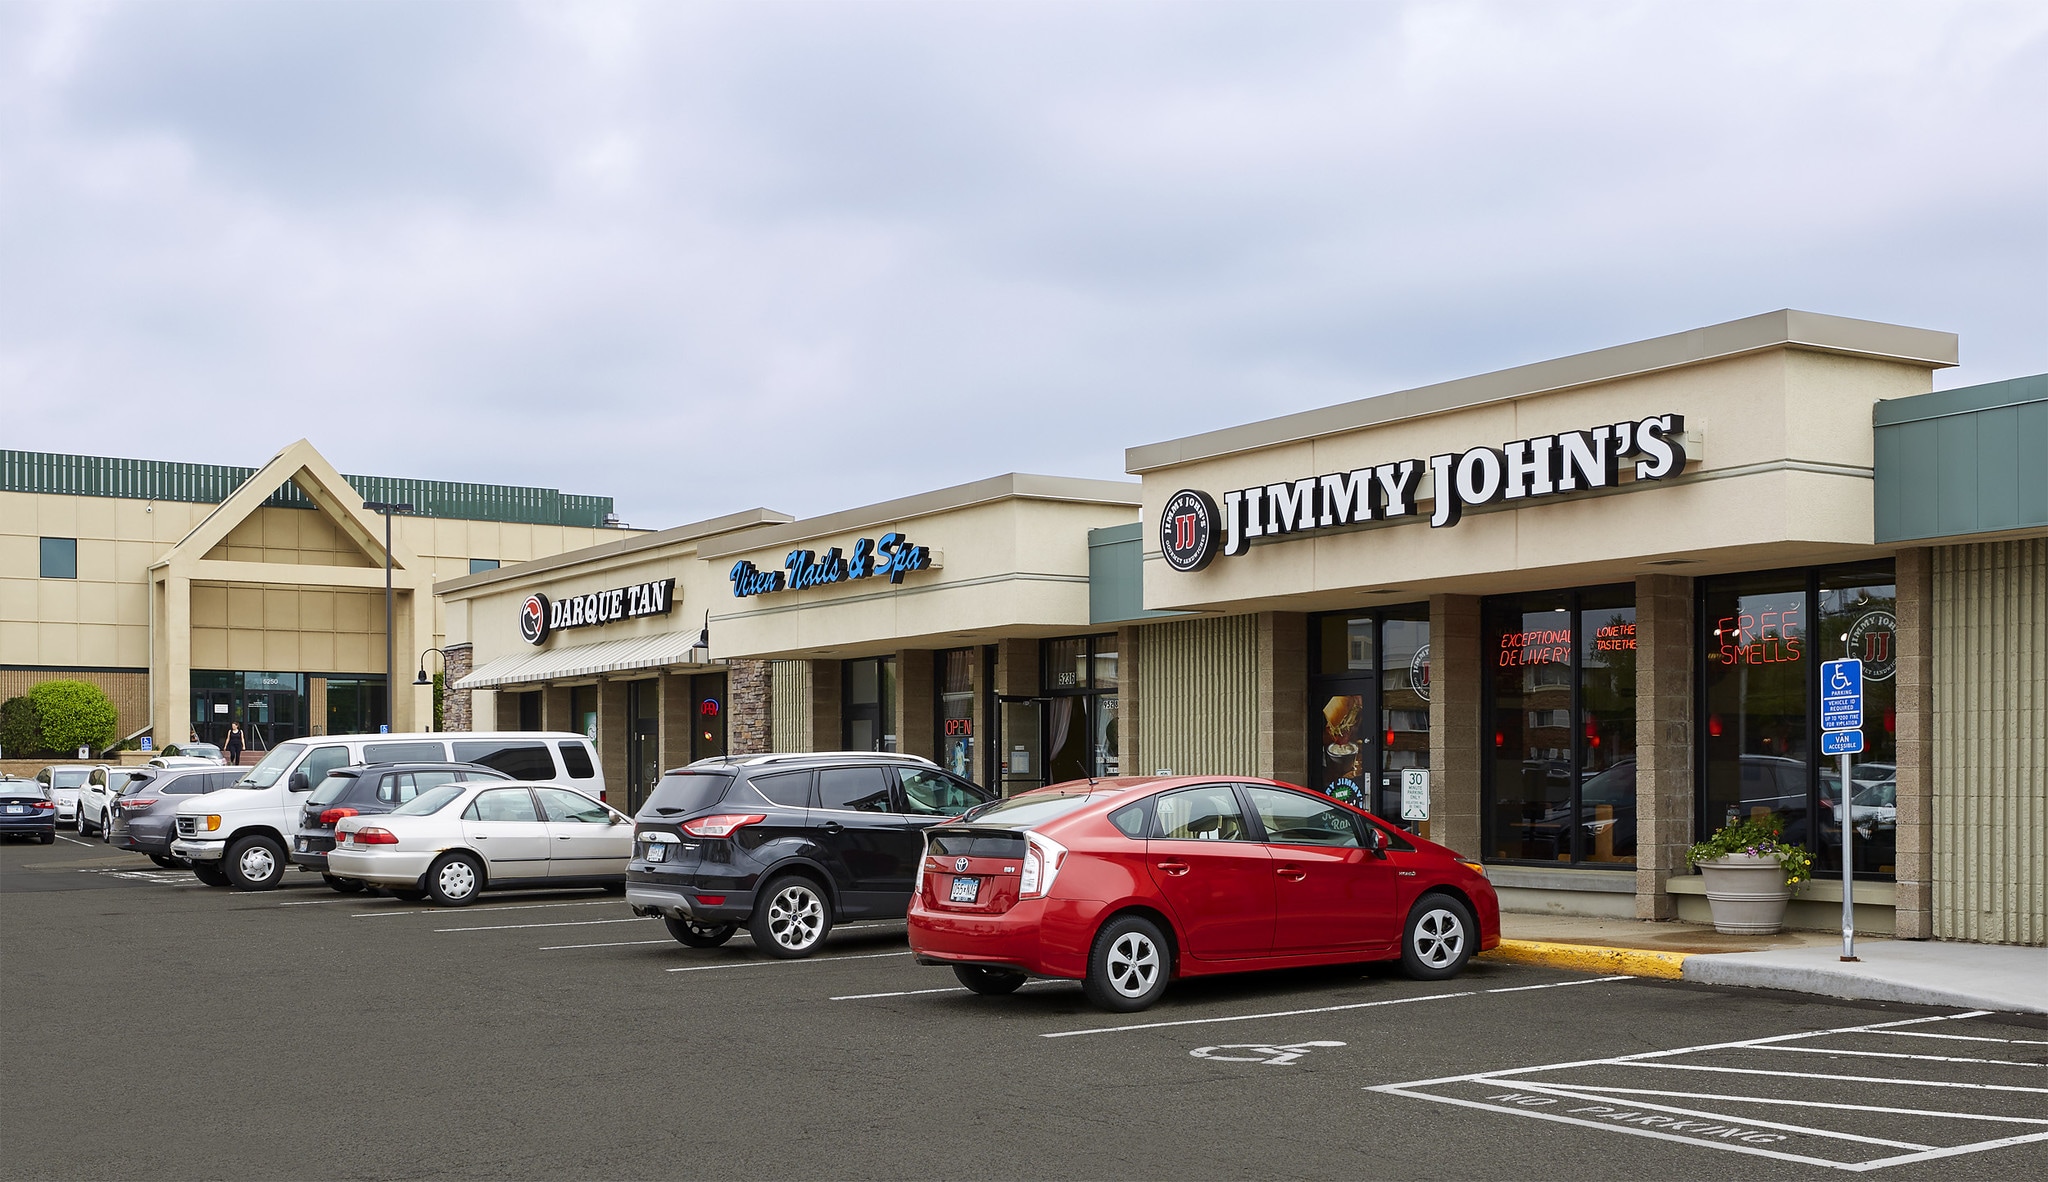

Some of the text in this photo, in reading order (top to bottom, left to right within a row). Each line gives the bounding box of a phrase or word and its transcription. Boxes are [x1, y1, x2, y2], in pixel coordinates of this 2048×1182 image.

[1223, 415, 1676, 556] JIMMY JOHN'S
[1164, 496, 1207, 534] JIMMY JOHN'S
[1175, 513, 1196, 551] JJ
[730, 532, 924, 597] Vixen Nails & Spa
[549, 580, 667, 629] DARQUE TAN
[1501, 629, 1571, 648] EXCEPTIONAL
[1717, 610, 1799, 646] FREE
[1850, 616, 1896, 647] JIMMY JOH
[1499, 647, 1571, 667] DELIVERY
[1720, 639, 1801, 665] SMELLS
[1863, 631, 1891, 663] JJ
[945, 718, 972, 736] OPEN
[1835, 735, 1850, 743] VAN
[1828, 742, 1857, 750] ACCESSIBLE
[1408, 773, 1423, 785] 30
[1485, 1093, 1787, 1144] NO PARKING
